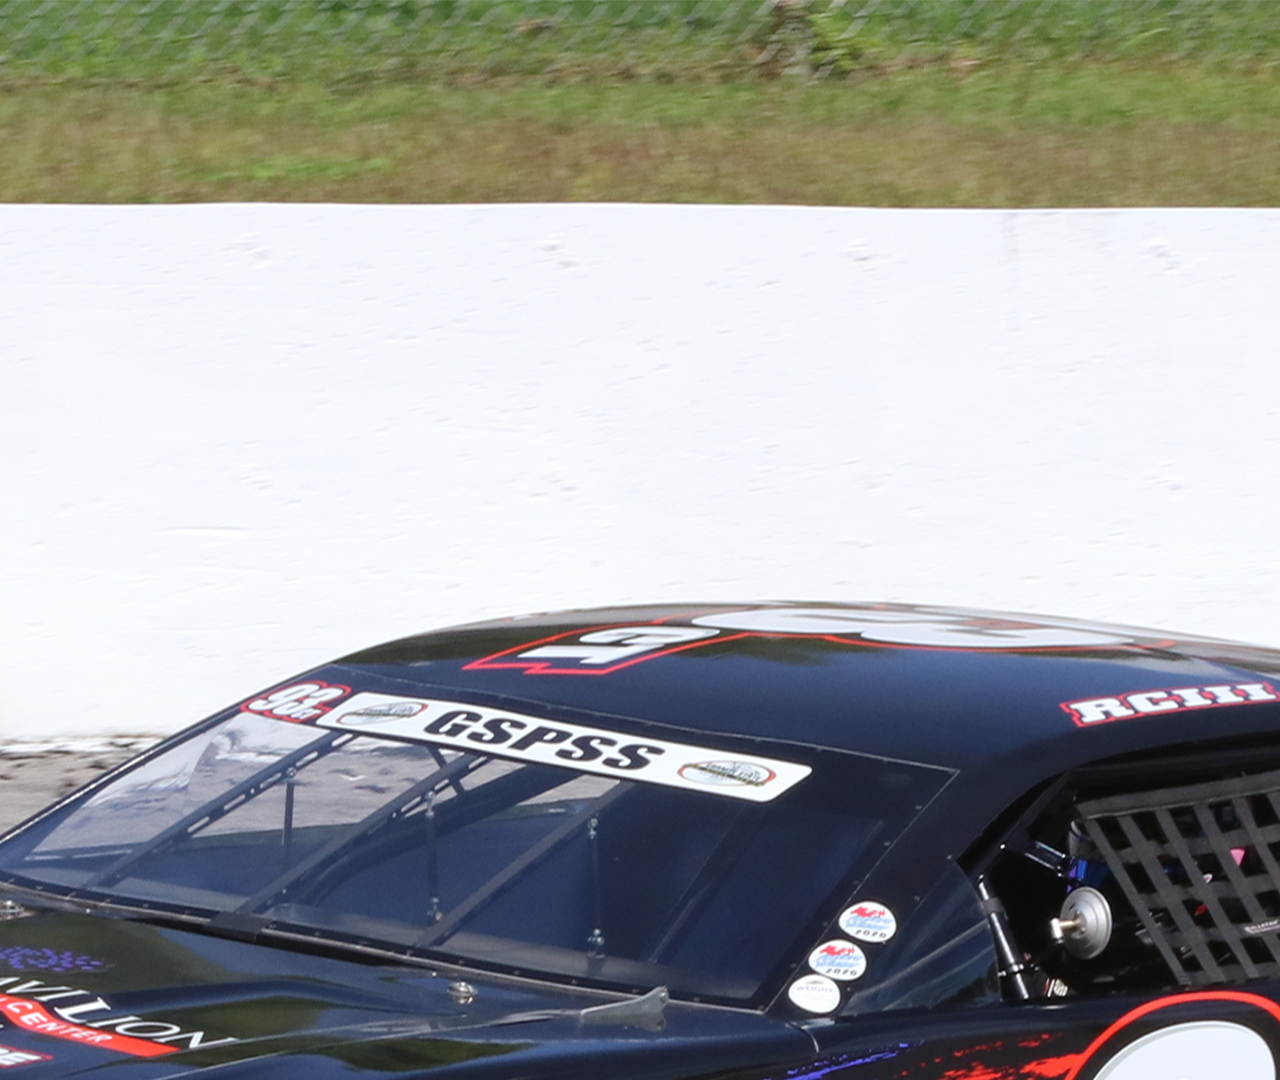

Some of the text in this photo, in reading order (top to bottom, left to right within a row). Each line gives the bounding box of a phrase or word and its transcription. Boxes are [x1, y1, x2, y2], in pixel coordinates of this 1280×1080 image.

[1069, 683, 1279, 726] RCIII
[423, 710, 666, 771] GSPSS
[6, 1001, 114, 1044] CENTER
